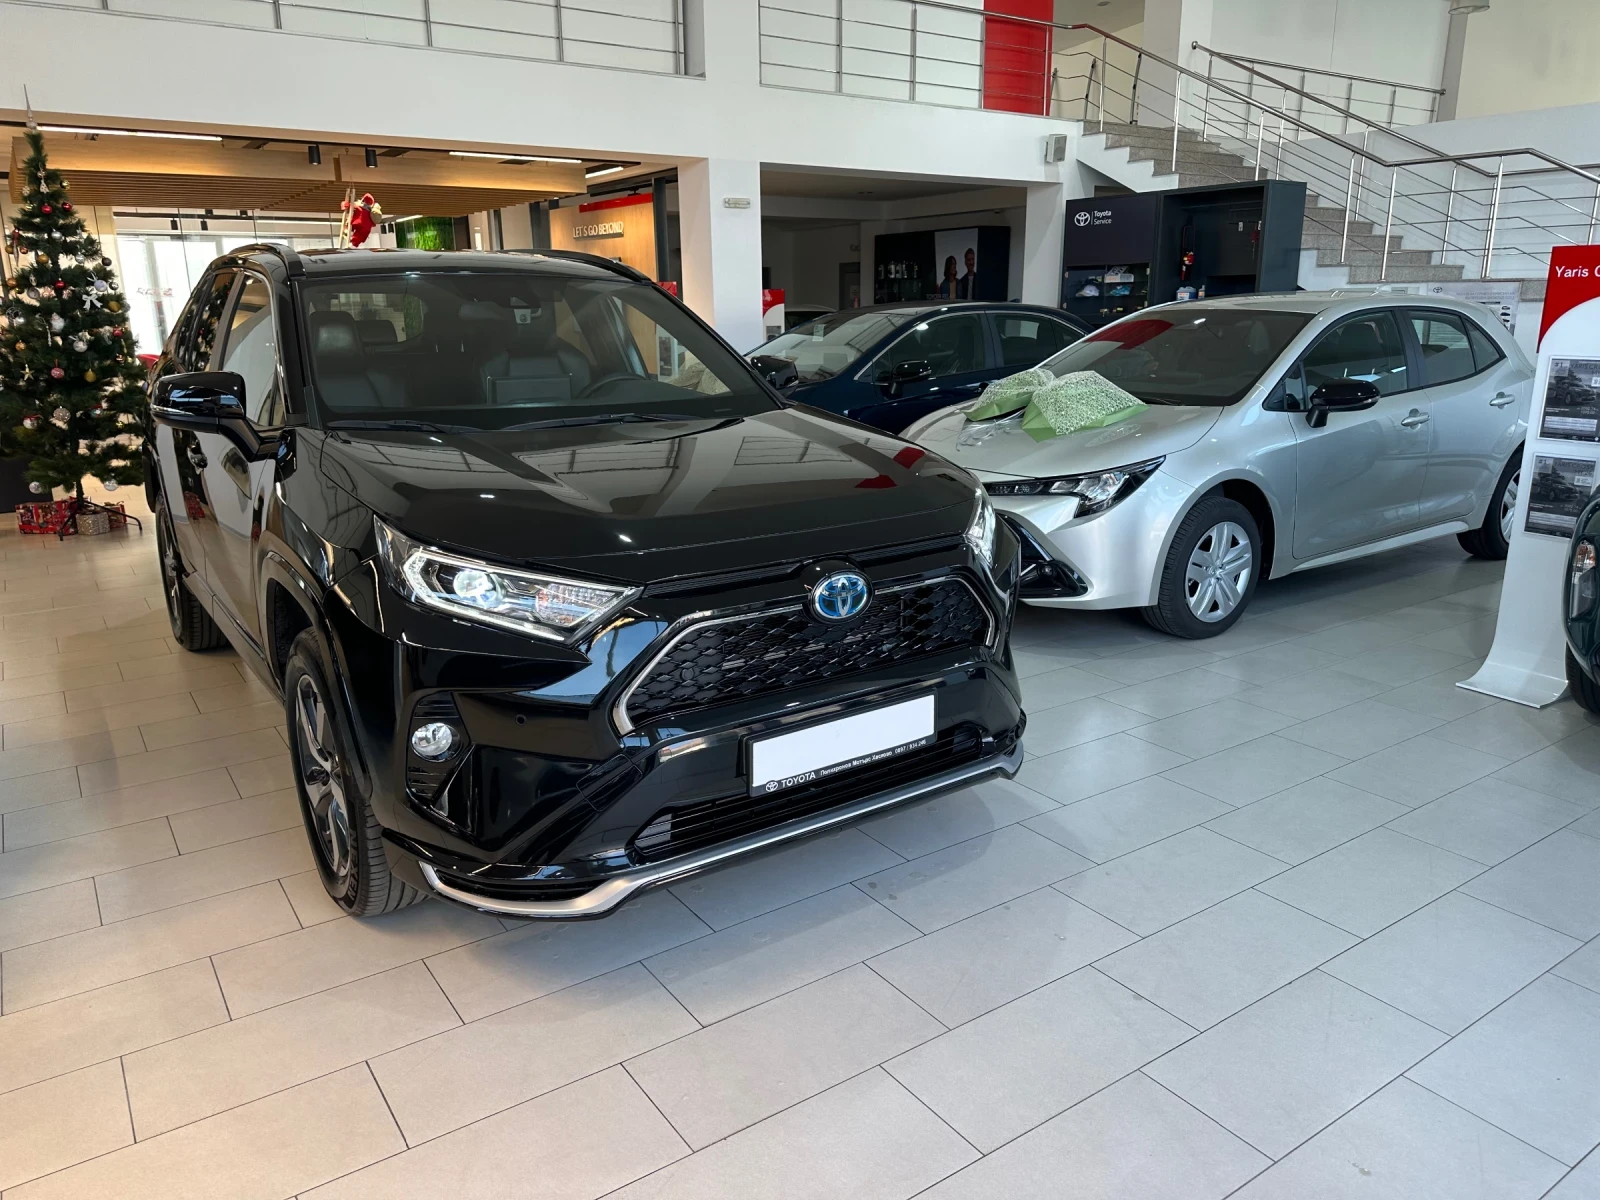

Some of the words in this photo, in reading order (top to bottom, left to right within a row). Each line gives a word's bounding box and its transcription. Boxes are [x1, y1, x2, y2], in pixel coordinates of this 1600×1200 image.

[1094, 210, 1111, 218] Toyota
[588, 224, 598, 236] GO
[598, 221, 624, 235] BEYOND
[1555, 265, 1588, 278] Yaris
[781, 772, 816, 788] TOYOTA
